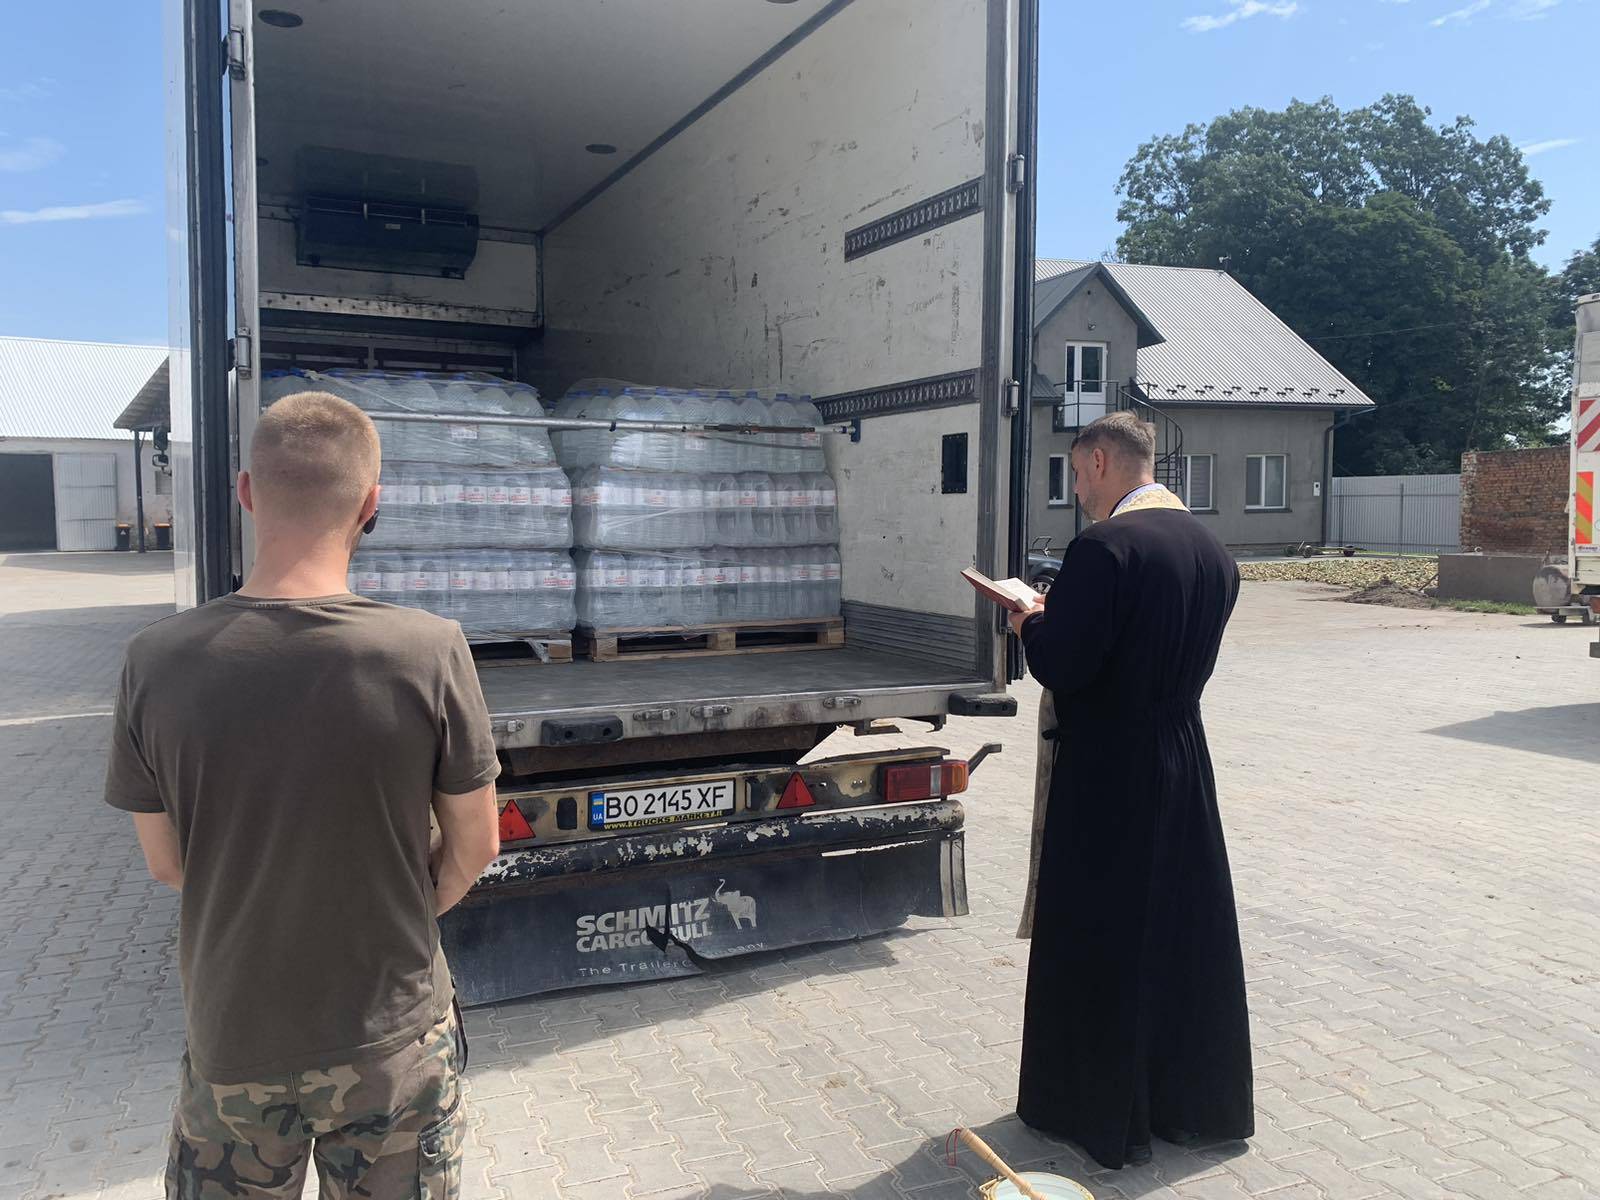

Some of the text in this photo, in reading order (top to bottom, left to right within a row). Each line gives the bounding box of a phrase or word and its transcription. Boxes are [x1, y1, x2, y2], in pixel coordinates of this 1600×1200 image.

[605, 785, 727, 819] BO 2145 XF
[592, 813, 603, 821] UA
[576, 897, 711, 936] SCHMITZ
[578, 966, 612, 977] The
[618, 960, 678, 972] Trailer
